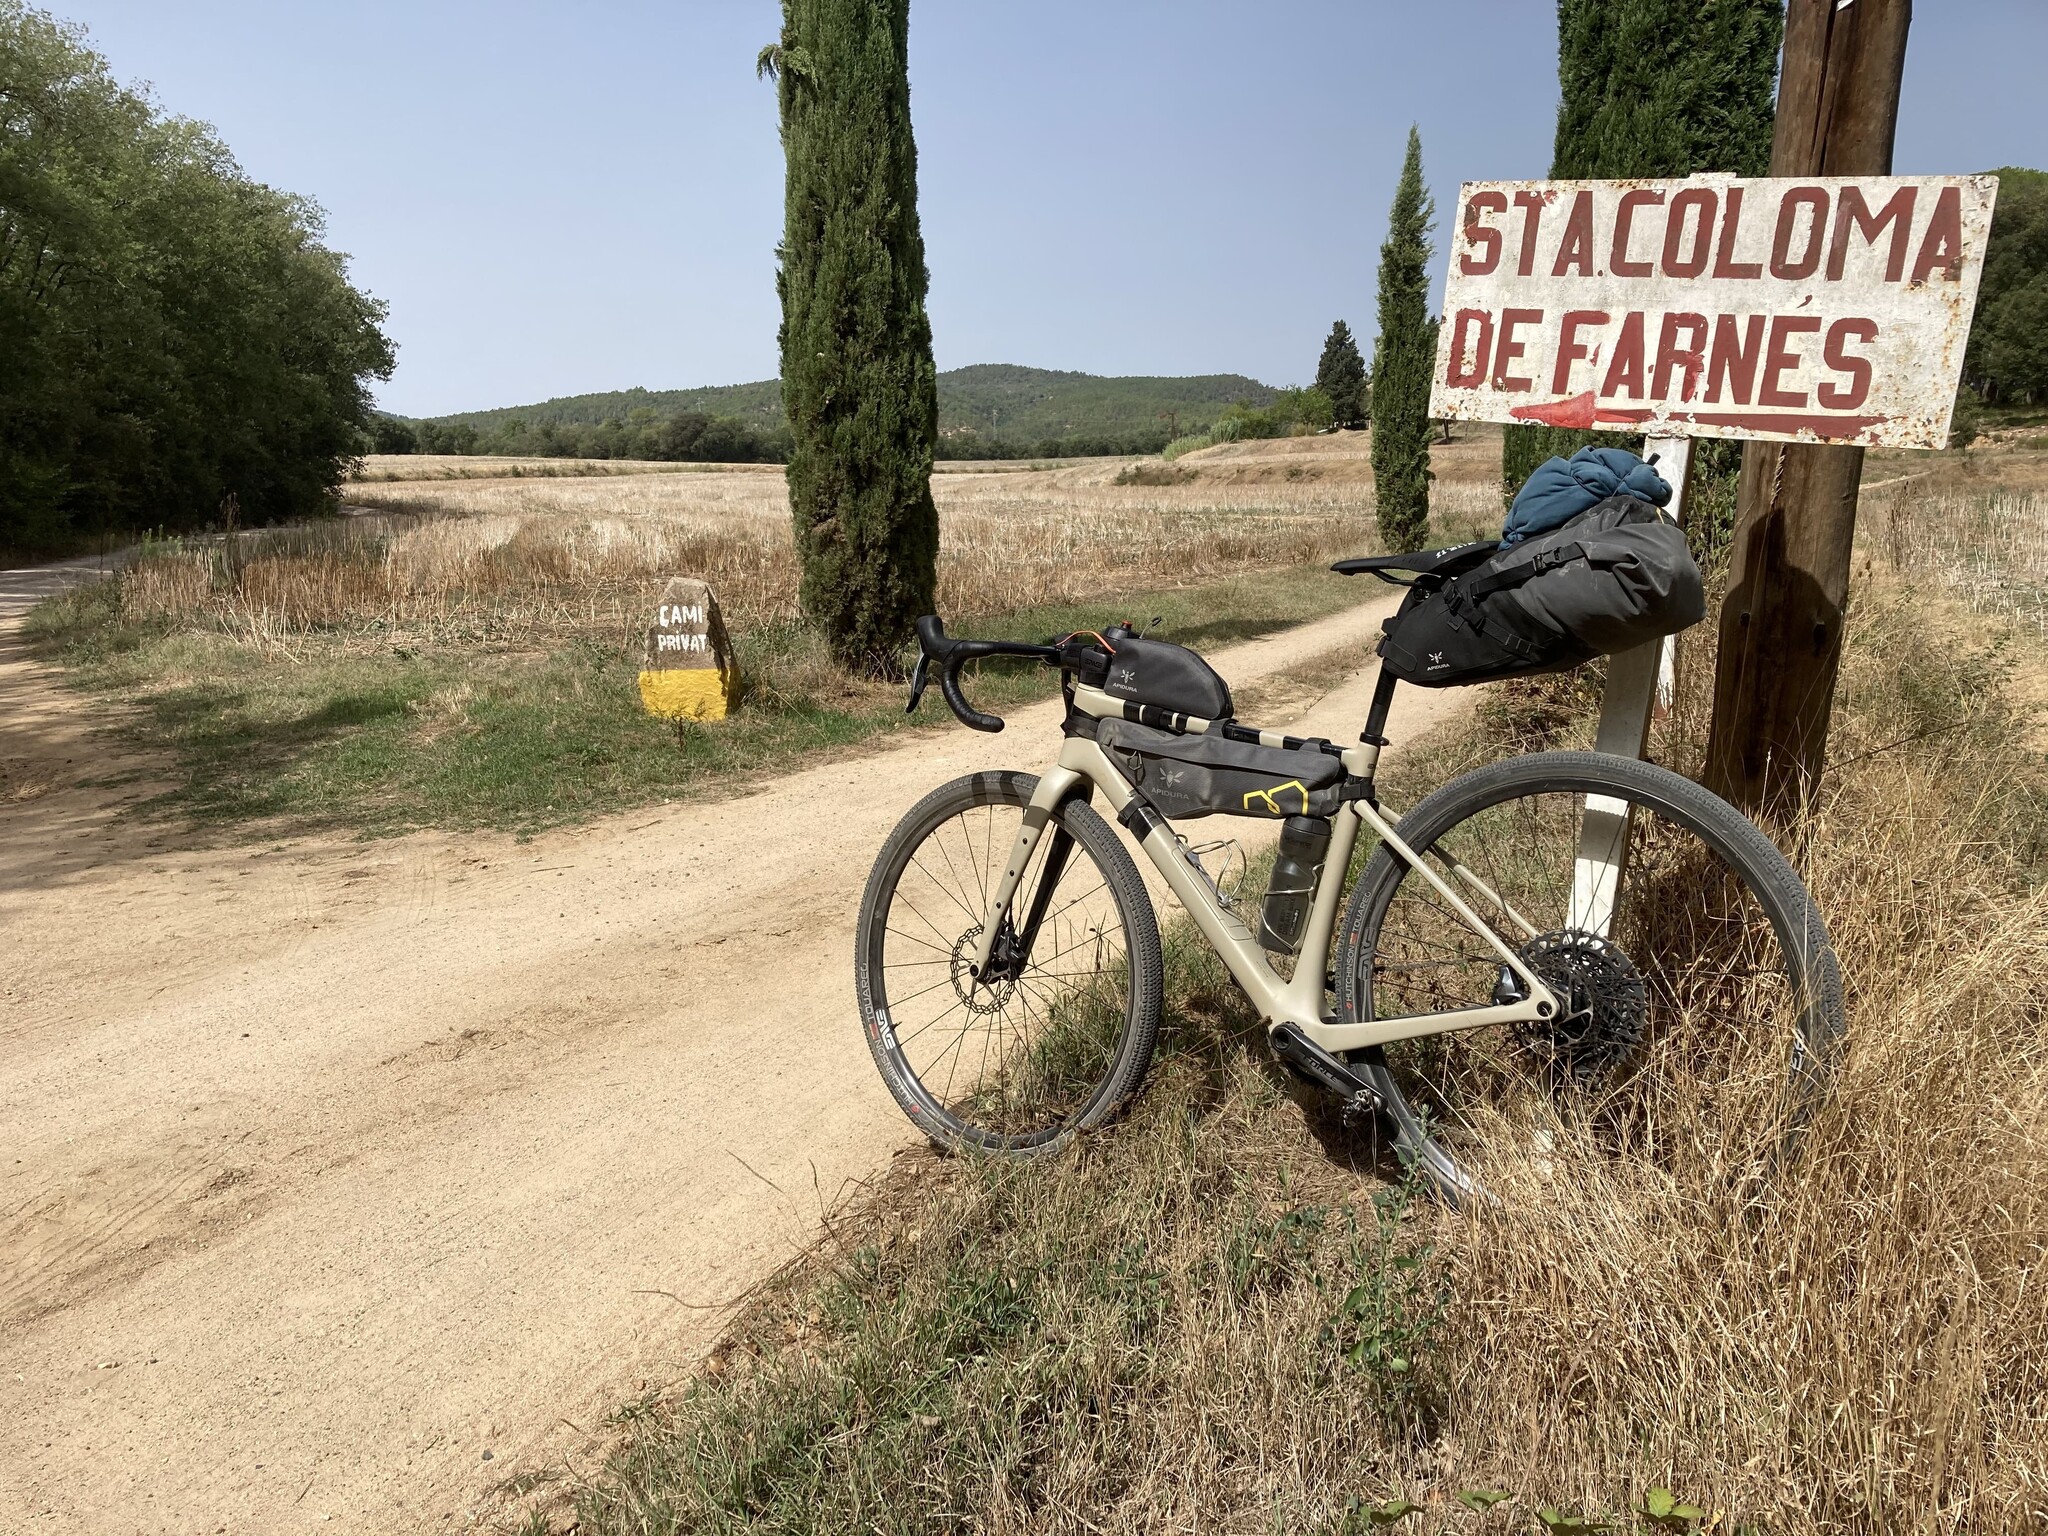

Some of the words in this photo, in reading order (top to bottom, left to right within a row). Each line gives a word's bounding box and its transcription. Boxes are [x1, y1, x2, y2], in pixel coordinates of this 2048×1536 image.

[1445, 307, 1543, 393] DE
[1112, 682, 1138, 693] APIDURA
[1151, 787, 1190, 800] APIDURA
[1345, 946, 1355, 1002] HUTCHINSON
[874, 1039, 914, 1105] HUTCHINSON
